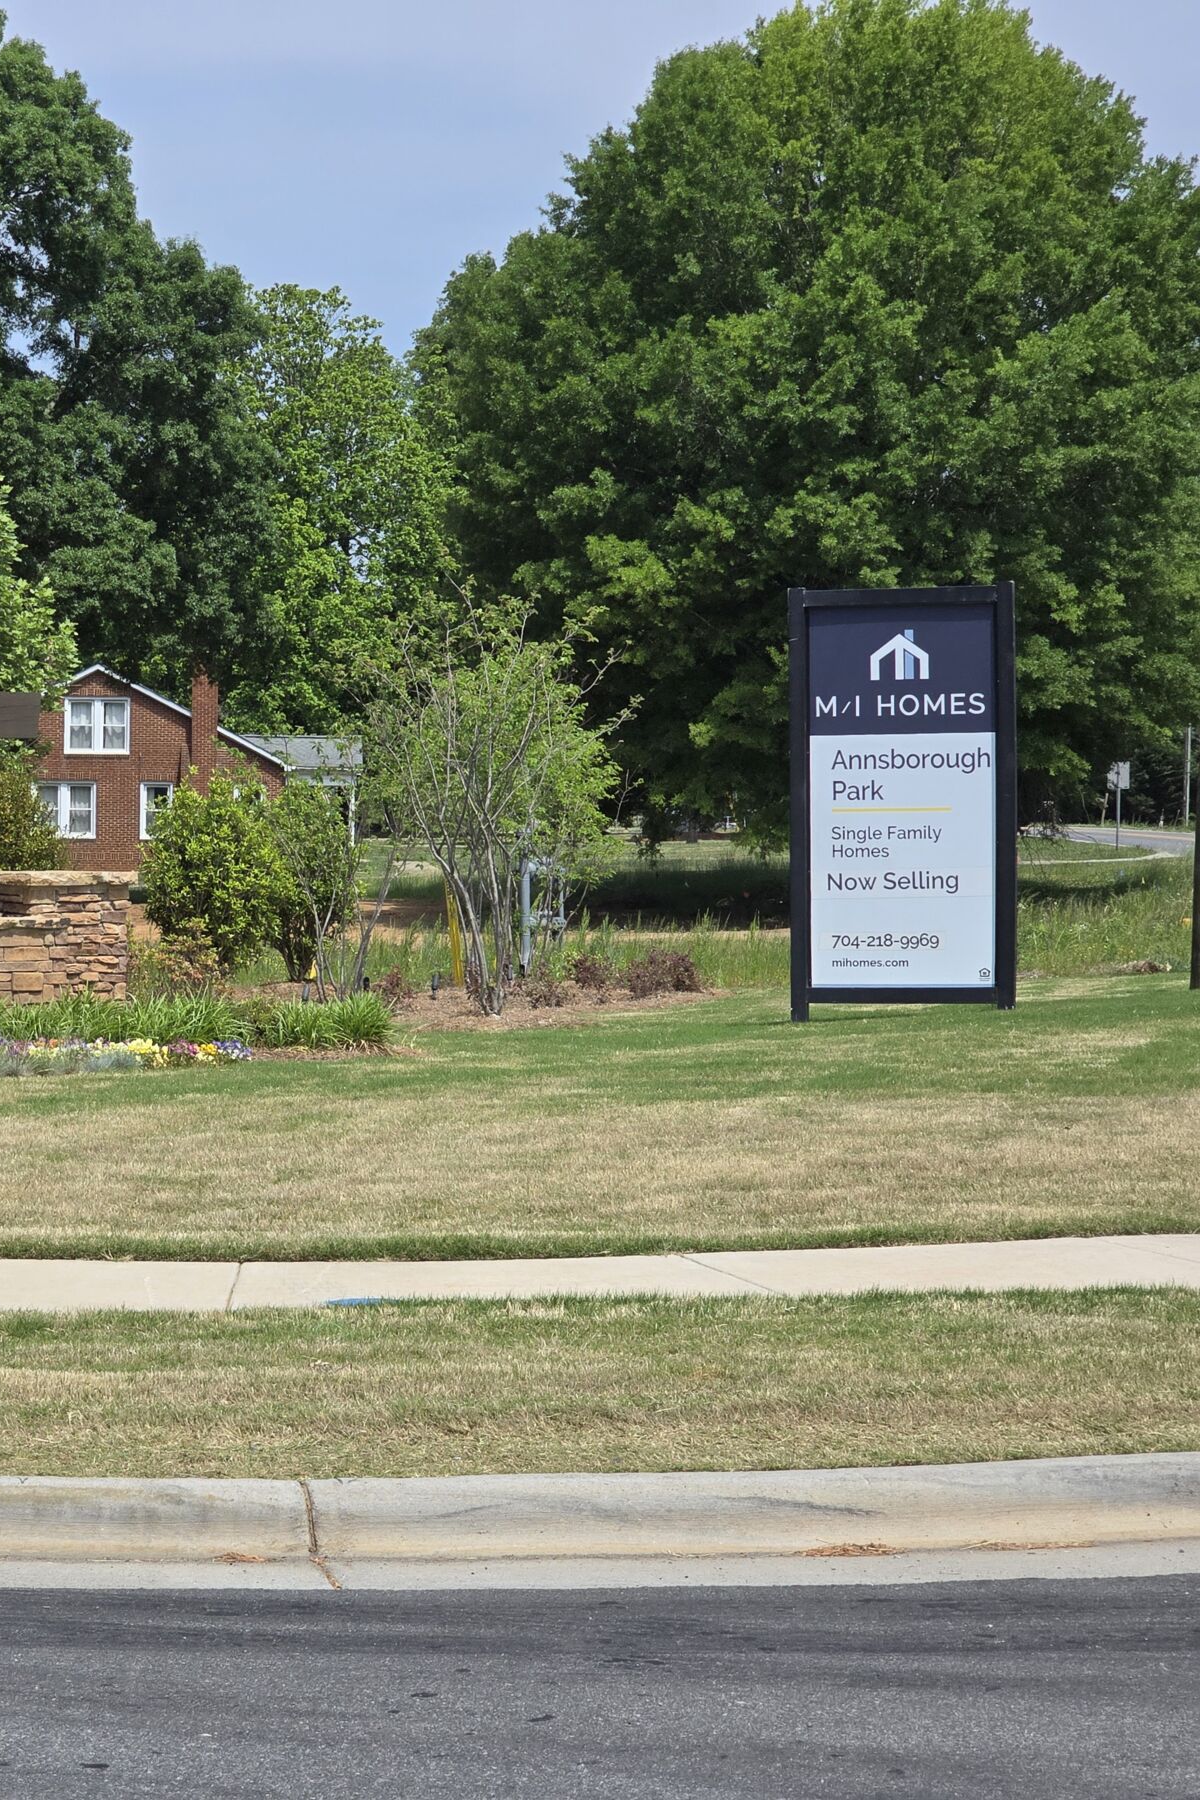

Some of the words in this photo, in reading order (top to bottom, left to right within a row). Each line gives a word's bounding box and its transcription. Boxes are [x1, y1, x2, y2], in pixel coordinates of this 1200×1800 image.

[877, 692, 987, 717] HOMES
[831, 746, 992, 775] Annsborough
[832, 779, 884, 801] Park
[831, 825, 884, 843] Single
[887, 825, 942, 843] Family
[831, 844, 890, 859] Homes
[827, 872, 878, 891] Now
[883, 870, 960, 895] Selling
[831, 932, 940, 950] 704-218-9969
[831, 957, 909, 968] mihomes.com
